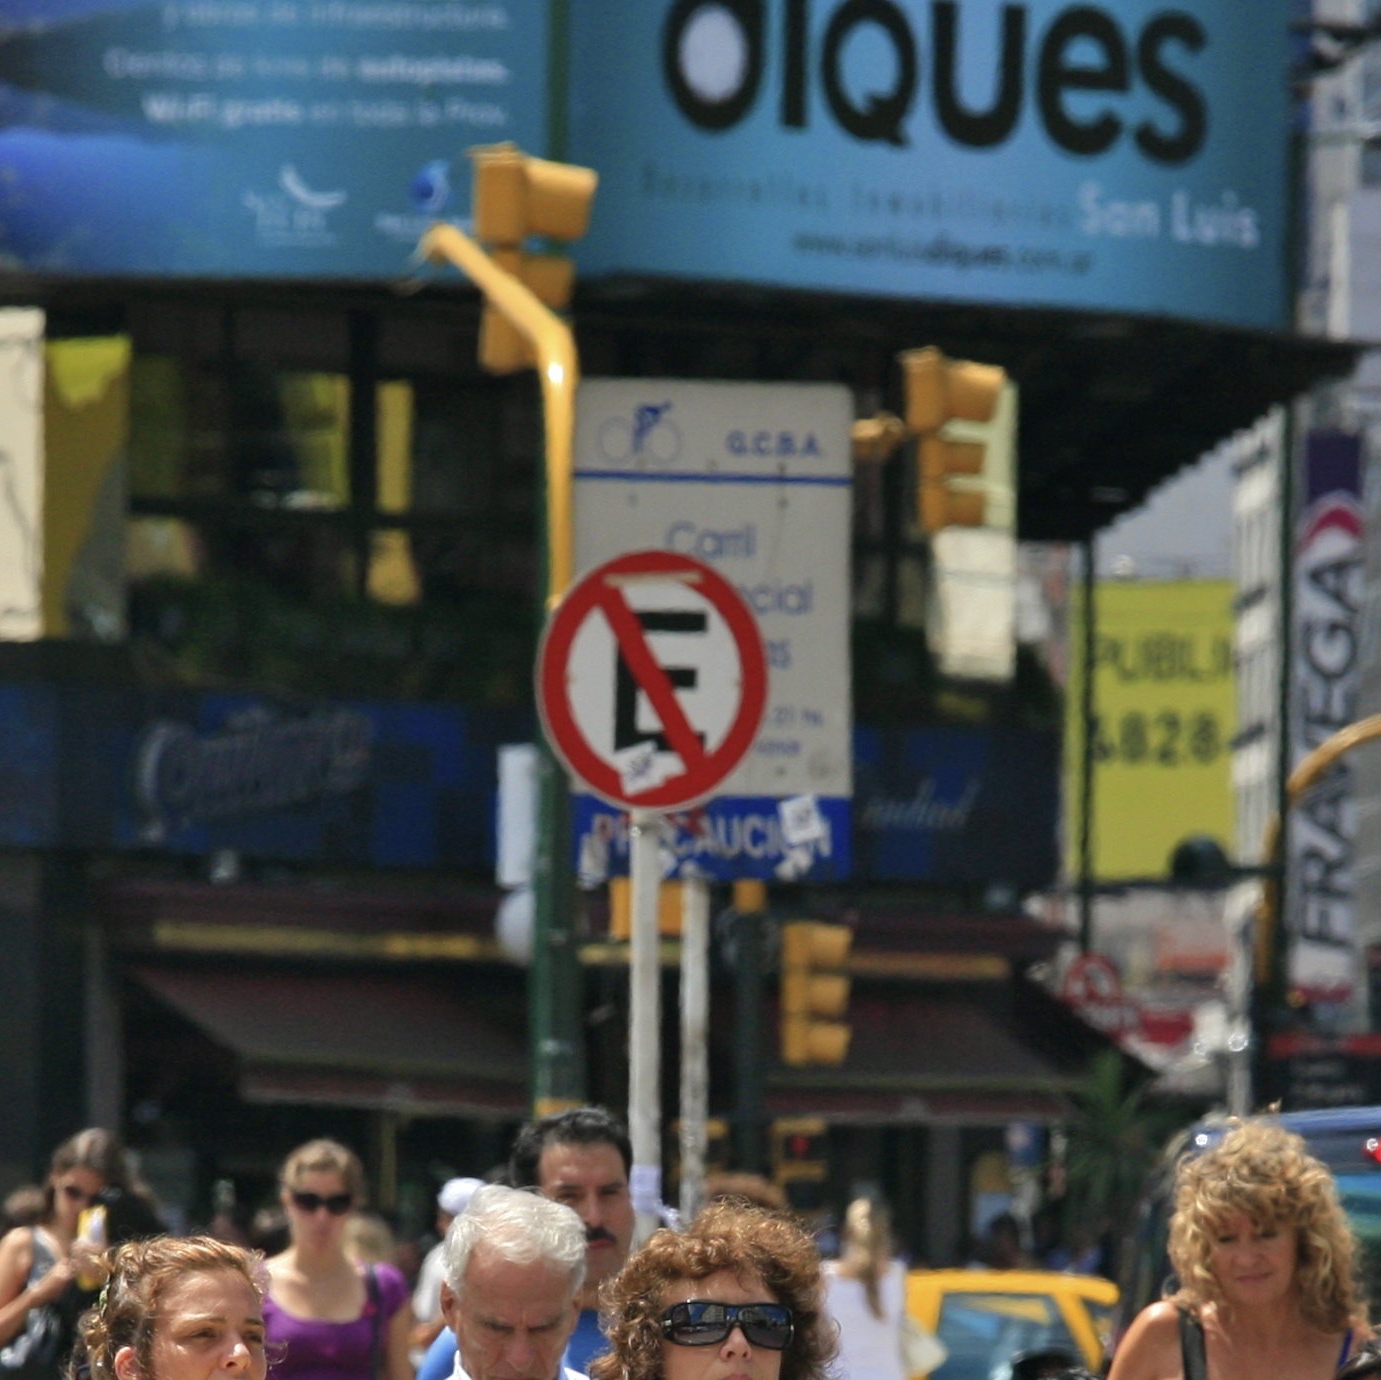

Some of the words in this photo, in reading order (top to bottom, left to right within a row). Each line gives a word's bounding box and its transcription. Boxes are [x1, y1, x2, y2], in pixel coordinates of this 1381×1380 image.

[1078, 180, 1161, 238] San
[1171, 190, 1261, 249] Luis
[665, 519, 758, 559] Carril
